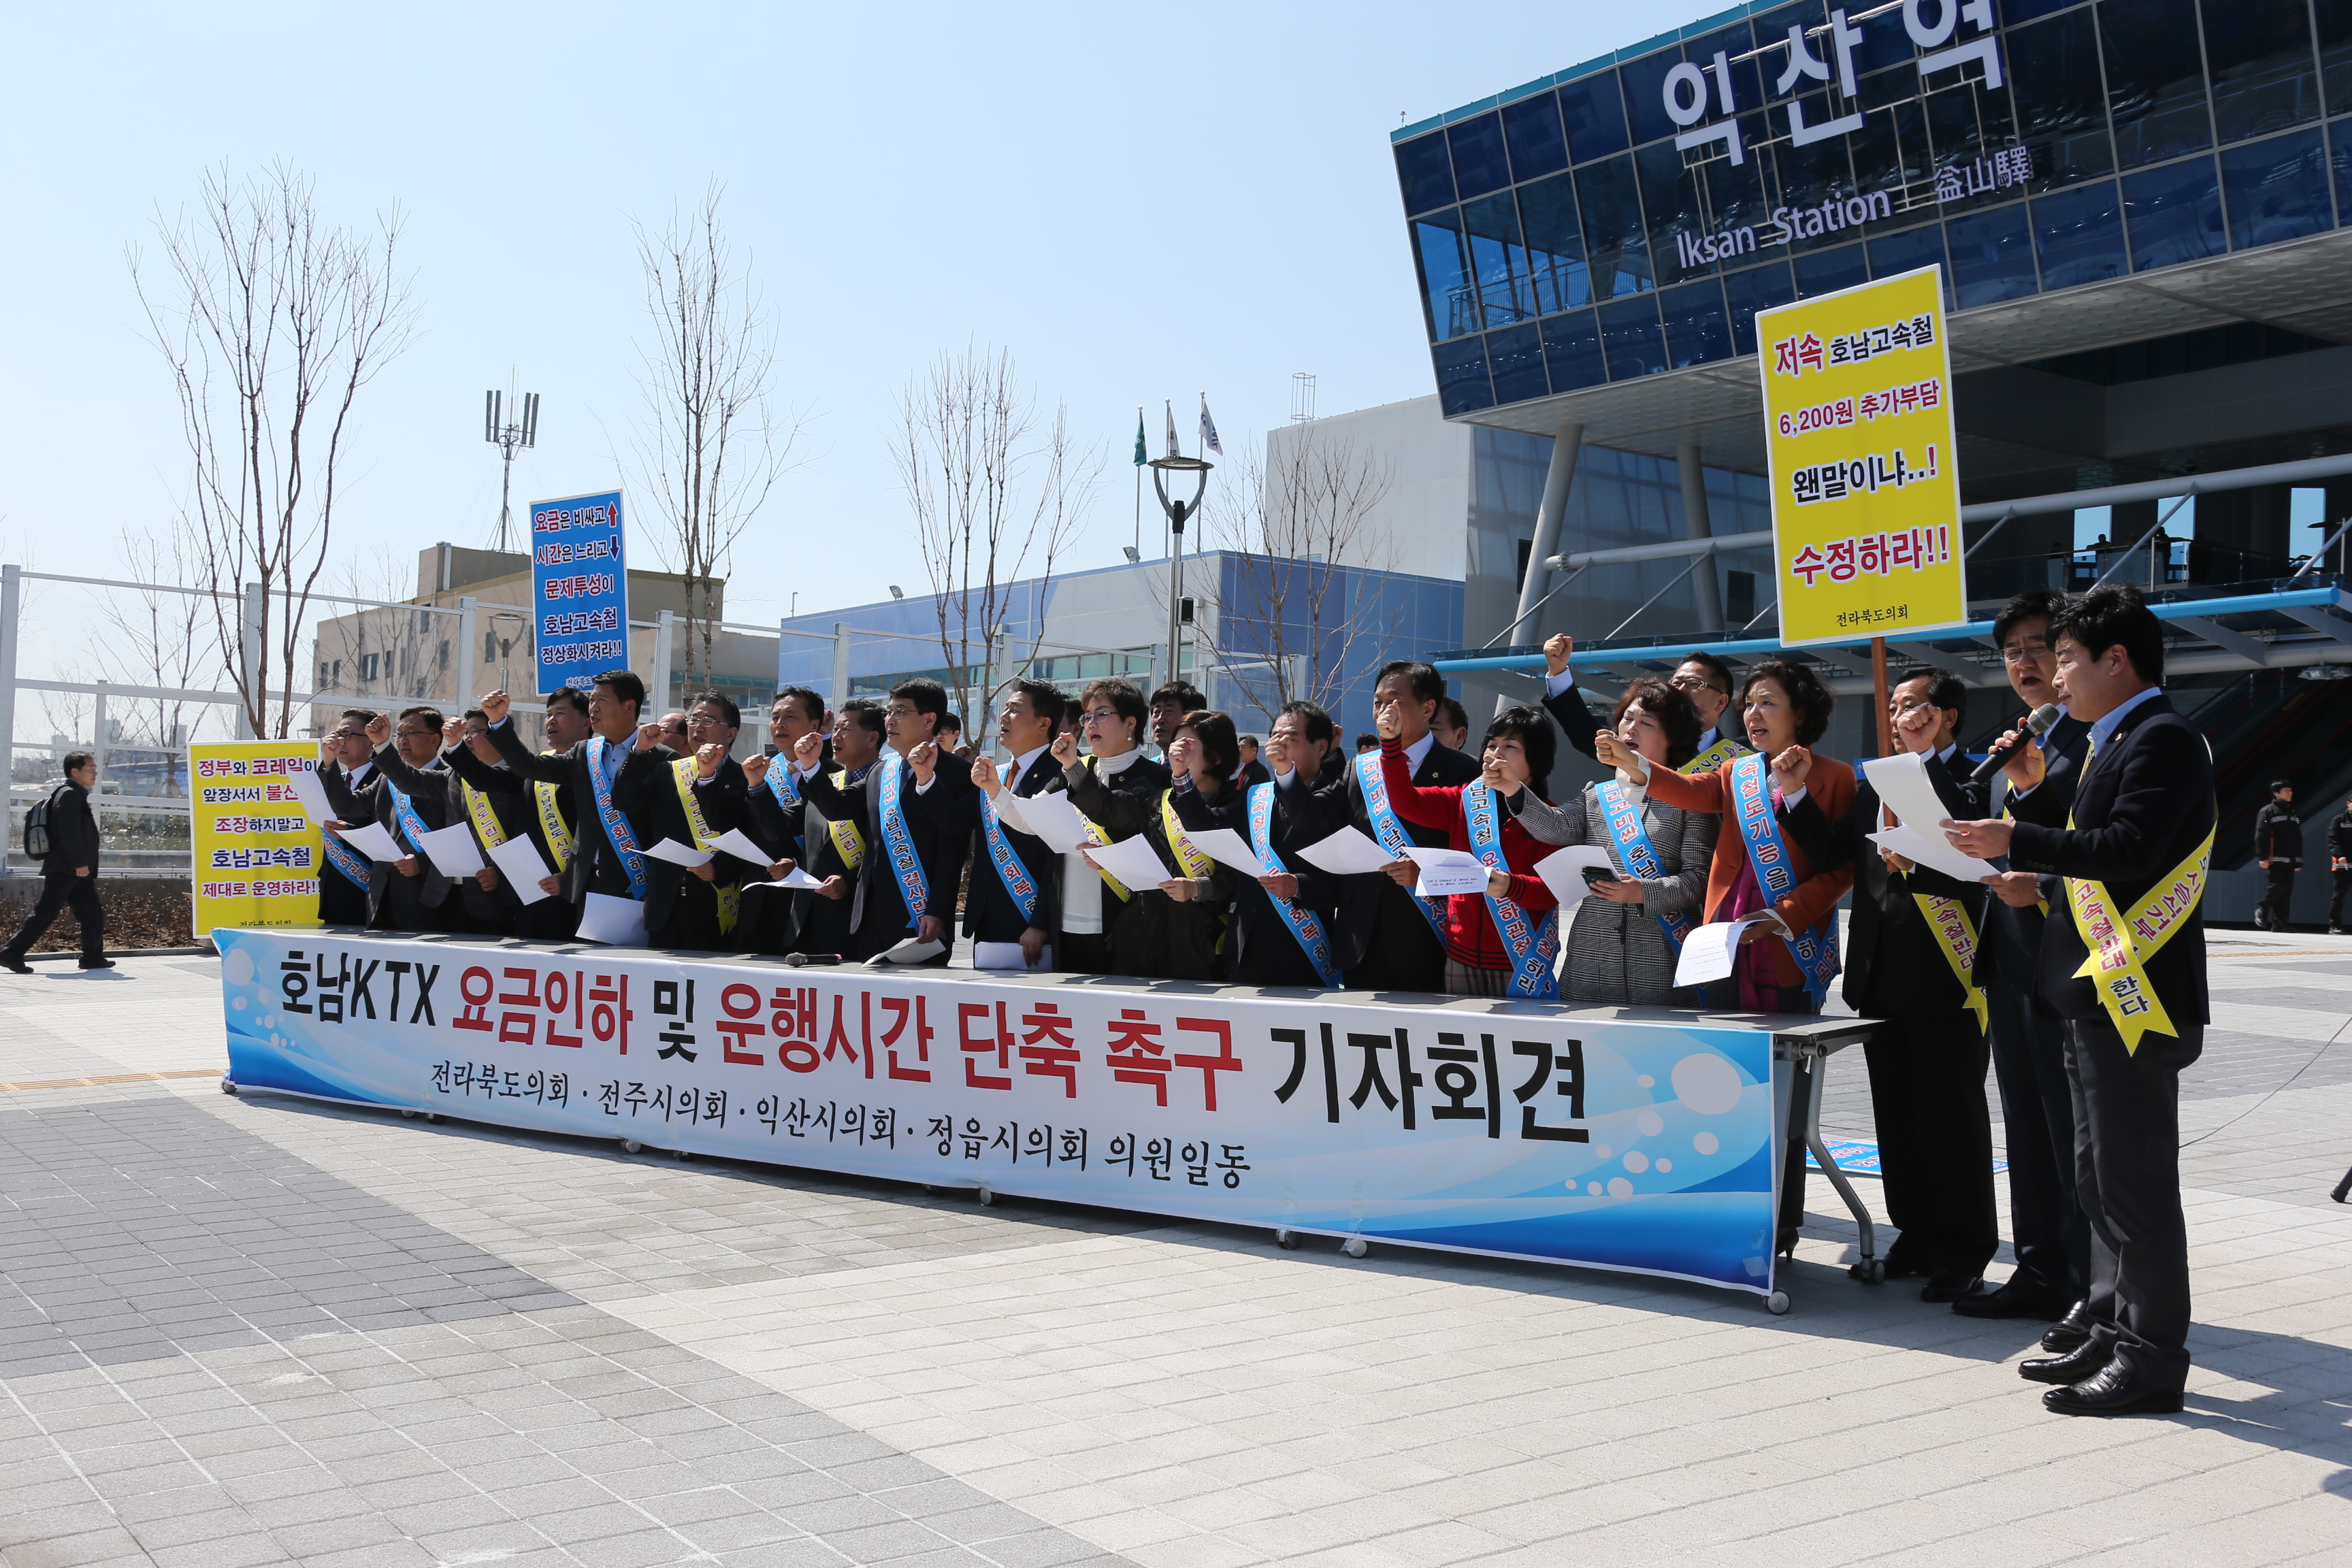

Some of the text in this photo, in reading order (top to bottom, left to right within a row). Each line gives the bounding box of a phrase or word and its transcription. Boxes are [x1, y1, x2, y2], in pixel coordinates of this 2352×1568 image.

[1663, 0, 2006, 166] 익산역
[1677, 191, 1893, 269] Iksan Station
[1774, 315, 1933, 376] 저속 호남고속철
[1779, 379, 1940, 436] 6,200원 추가부담
[1793, 445, 1937, 504] 왠말이냐..!
[535, 506, 606, 532] 요금은 비싸고
[536, 540, 608, 565] 시간은 느리고
[1793, 525, 1948, 585] 수정하라!!
[544, 574, 614, 600] 문제투성이
[544, 608, 618, 635] 호남고속철
[1835, 604, 1909, 627] 전라북도의회
[542, 641, 622, 664] 정상화시켜라!!
[198, 760, 247, 777] 정부와
[203, 787, 260, 802] 앞장서서
[215, 817, 306, 832] 조장하지말고
[212, 847, 311, 868] 호남고속철
[883, 804, 917, 871] 호남고속철
[901, 870, 928, 927] 결사반
[203, 883, 247, 897] 제대로
[280, 950, 1590, 1144] 호남KTX 요금인하 및 운행시간 단축 촉구 기자회견
[431, 1060, 1252, 1190] 전라북도의회 전주시의회 익산시의회 정읍시의회 의원일동
